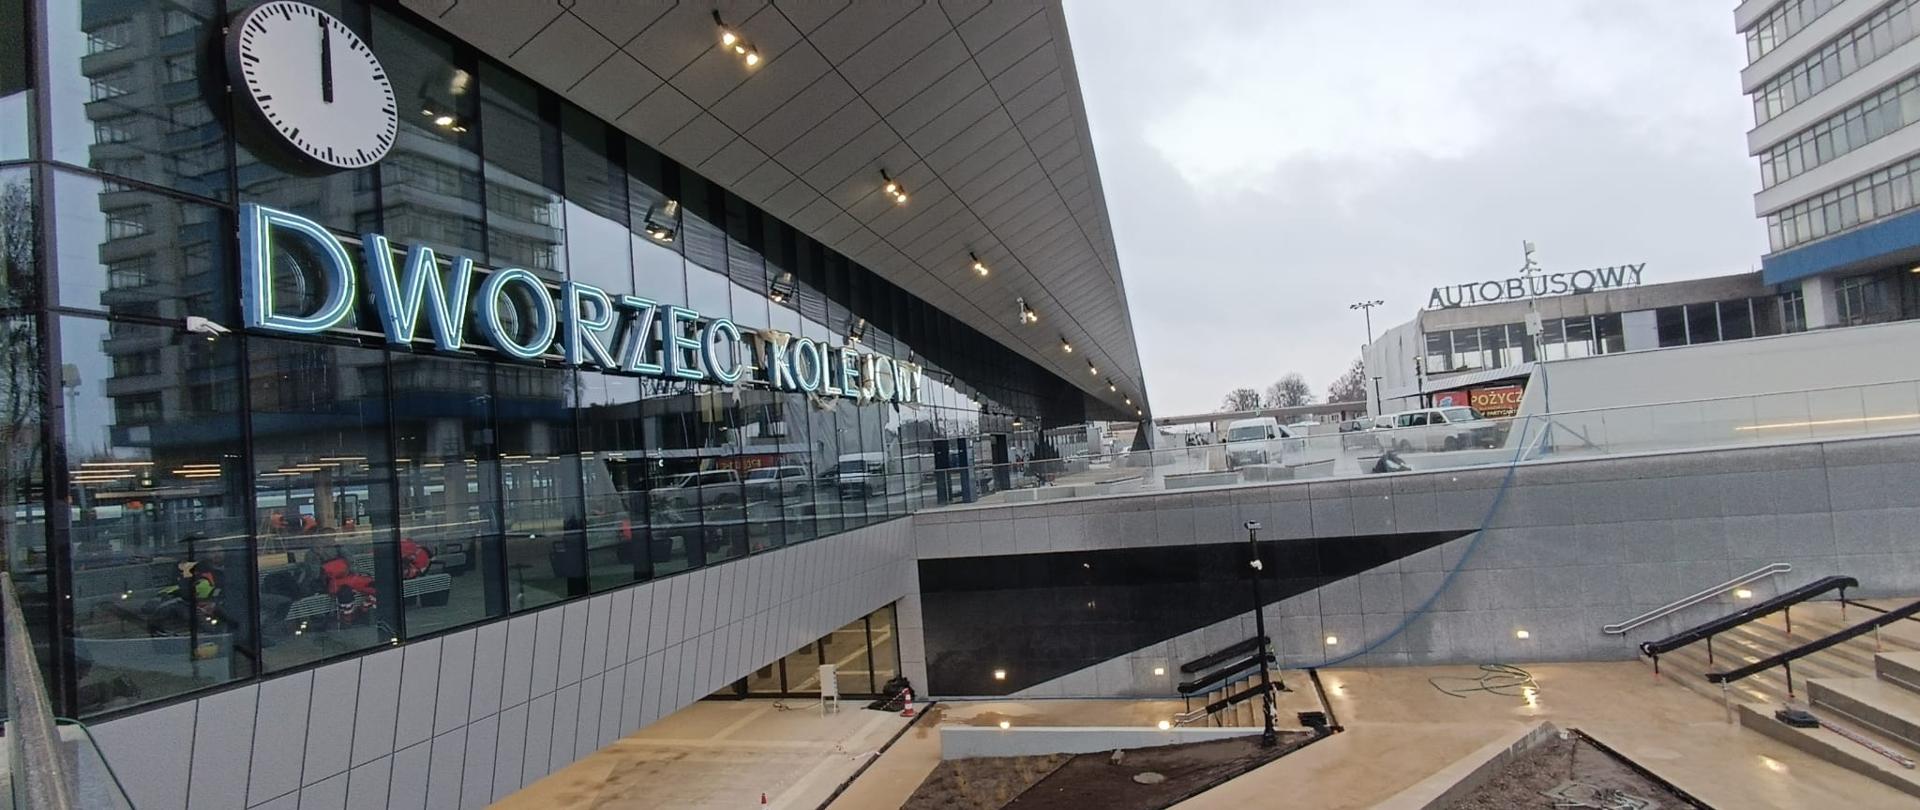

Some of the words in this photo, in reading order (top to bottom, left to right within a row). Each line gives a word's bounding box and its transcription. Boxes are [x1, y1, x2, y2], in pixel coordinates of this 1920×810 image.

[238, 202, 744, 386] DWORZEC
[767, 331, 922, 403] KOLEJOWY
[1428, 262, 1646, 309] AUTOBUSOWY
